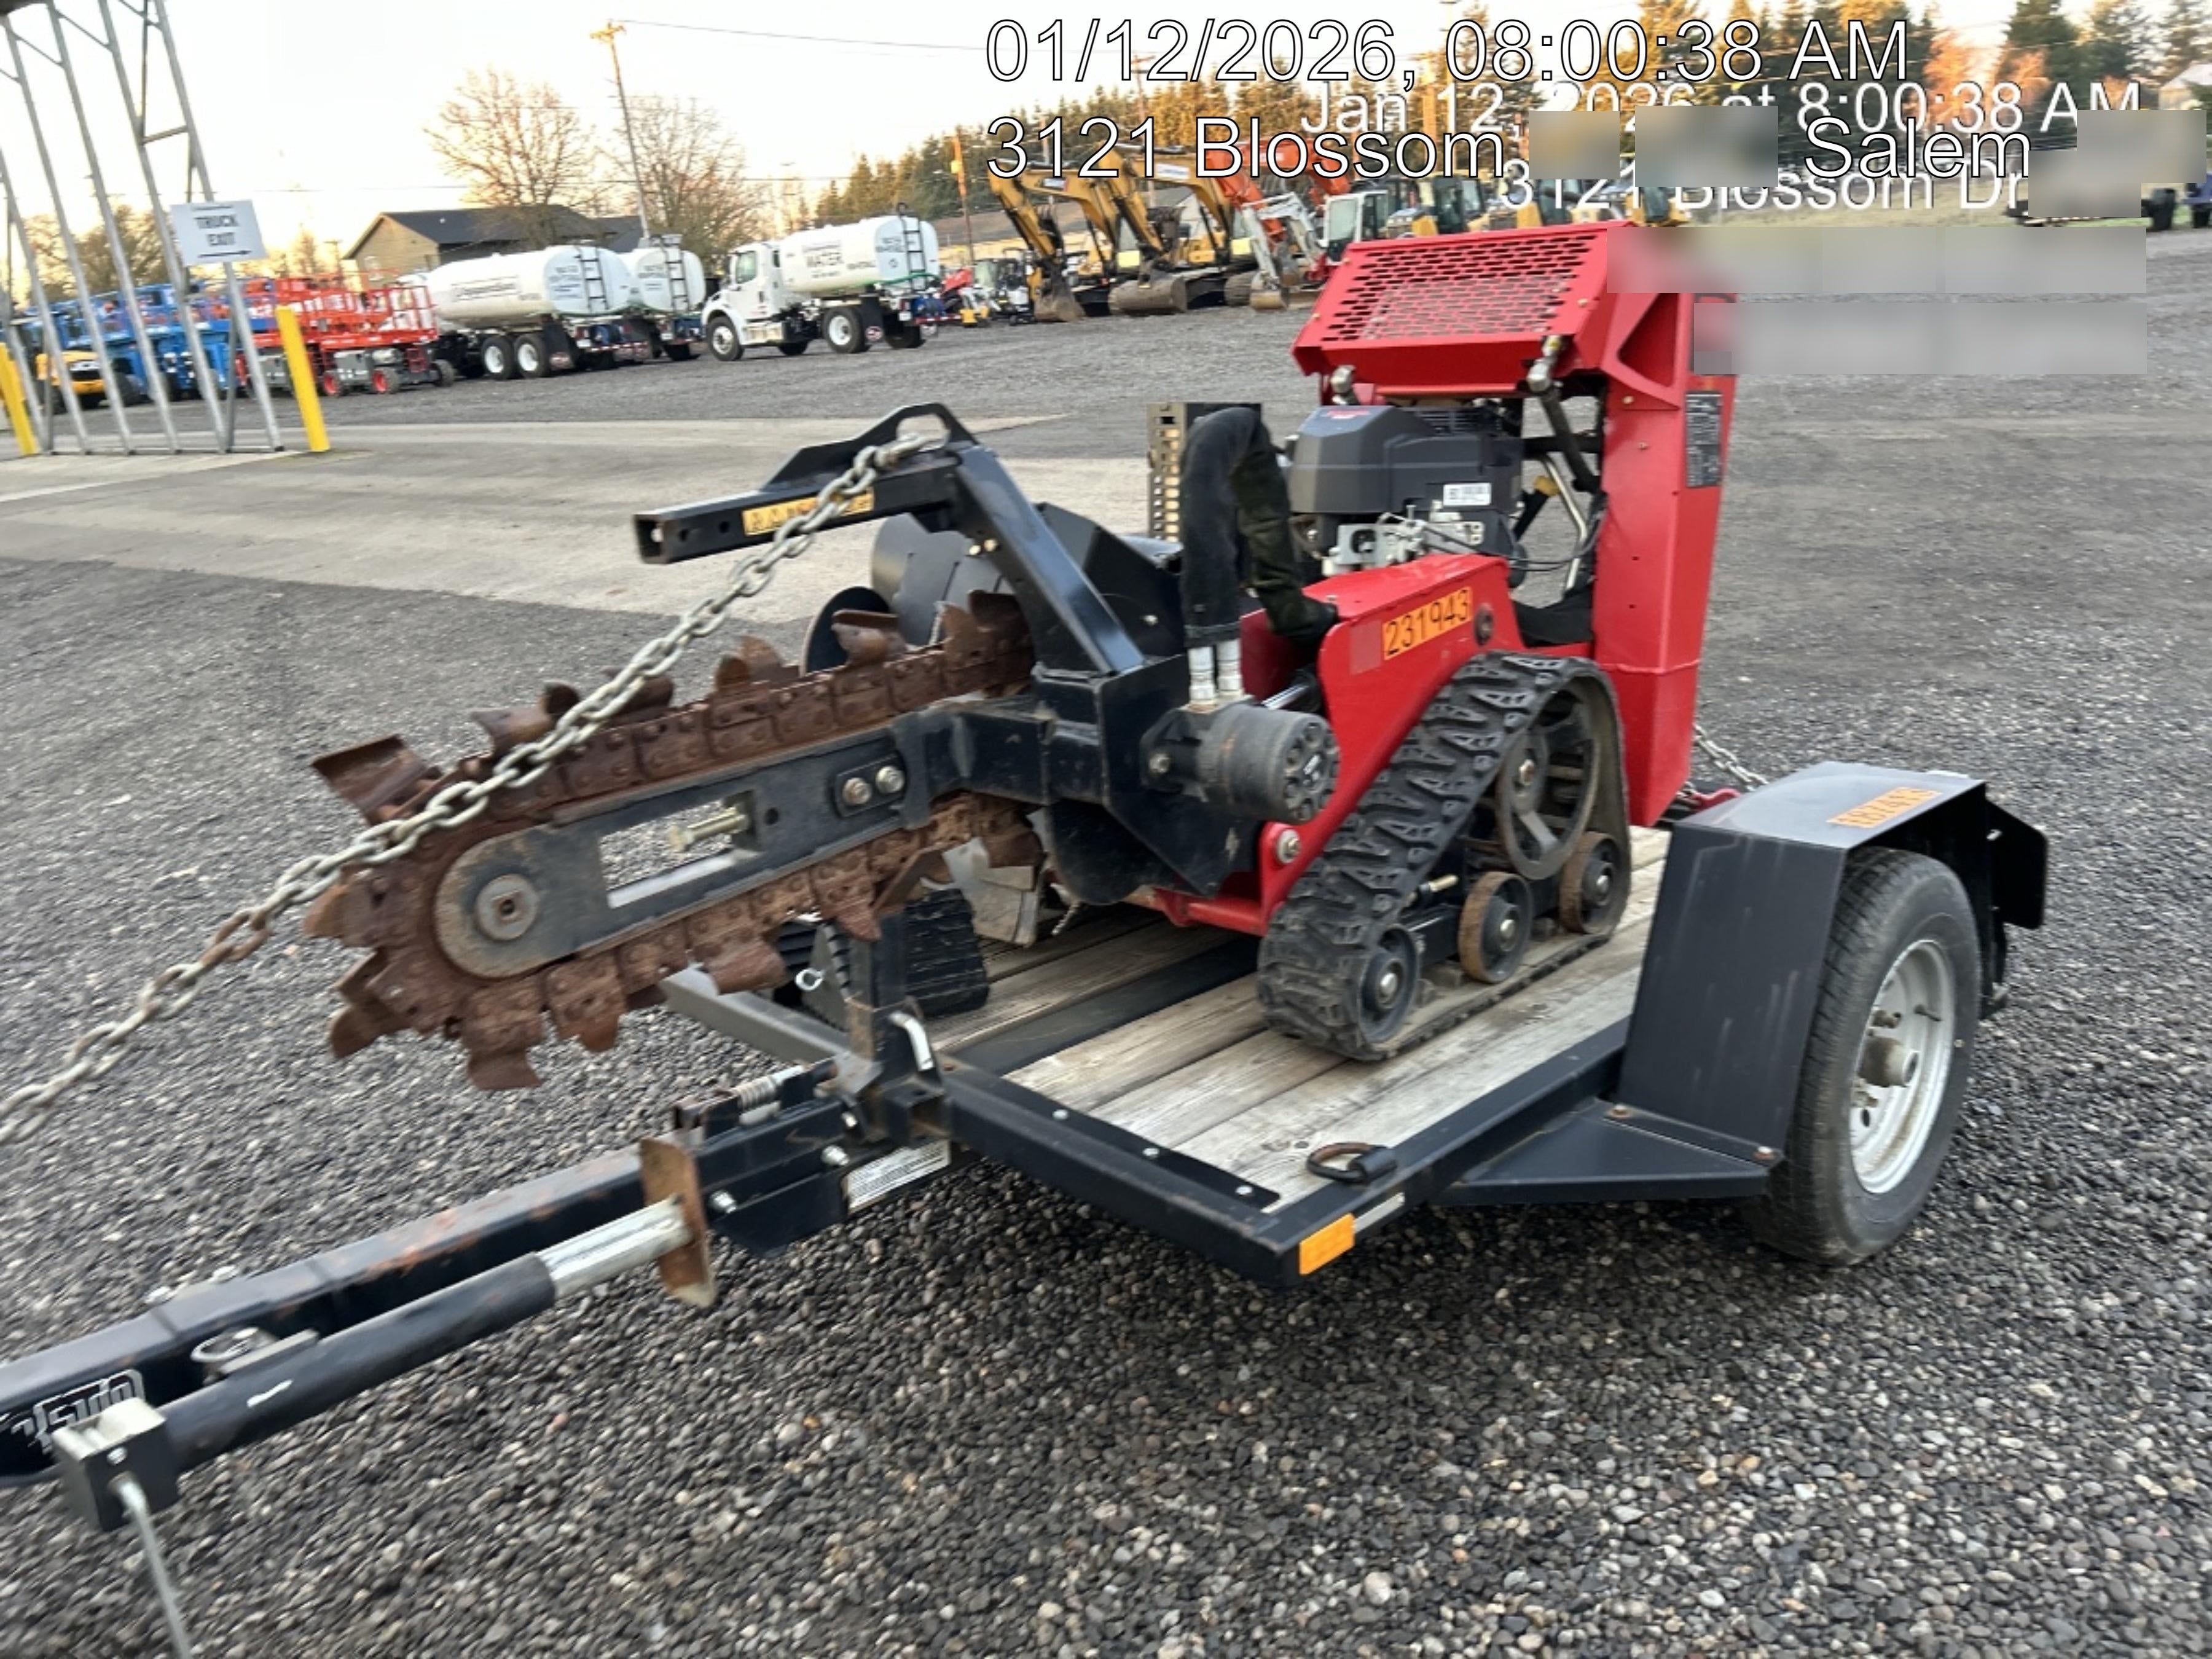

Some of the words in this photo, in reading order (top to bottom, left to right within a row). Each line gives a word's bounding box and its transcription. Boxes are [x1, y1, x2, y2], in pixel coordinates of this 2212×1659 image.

[194, 215, 239, 229] TRUCK
[206, 232, 235, 246] EXIT
[1386, 590, 1469, 655] 231943
